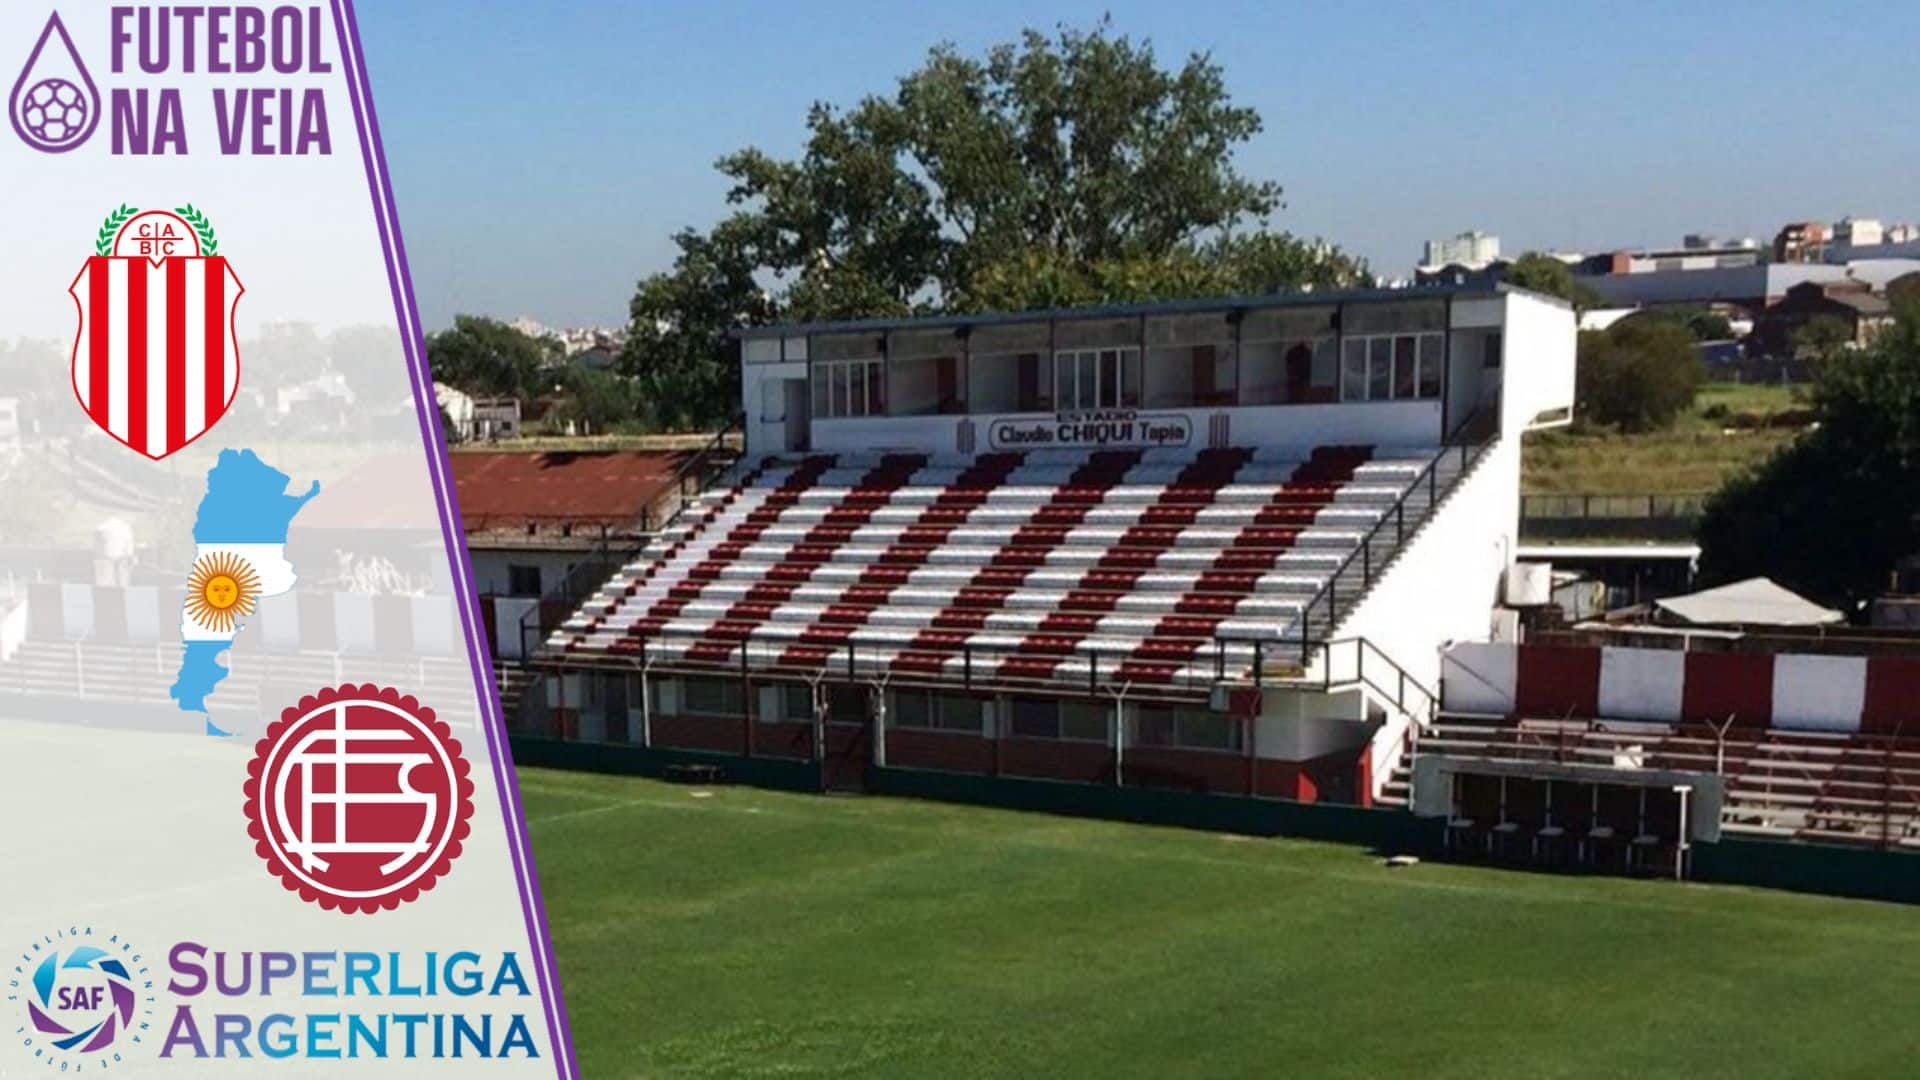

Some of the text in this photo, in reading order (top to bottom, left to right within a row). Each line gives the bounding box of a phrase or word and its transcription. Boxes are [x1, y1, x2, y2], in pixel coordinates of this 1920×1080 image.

[1056, 411, 1137, 423] ESTADIO
[999, 422, 1185, 444] Claudio CHIQUI Tapia
